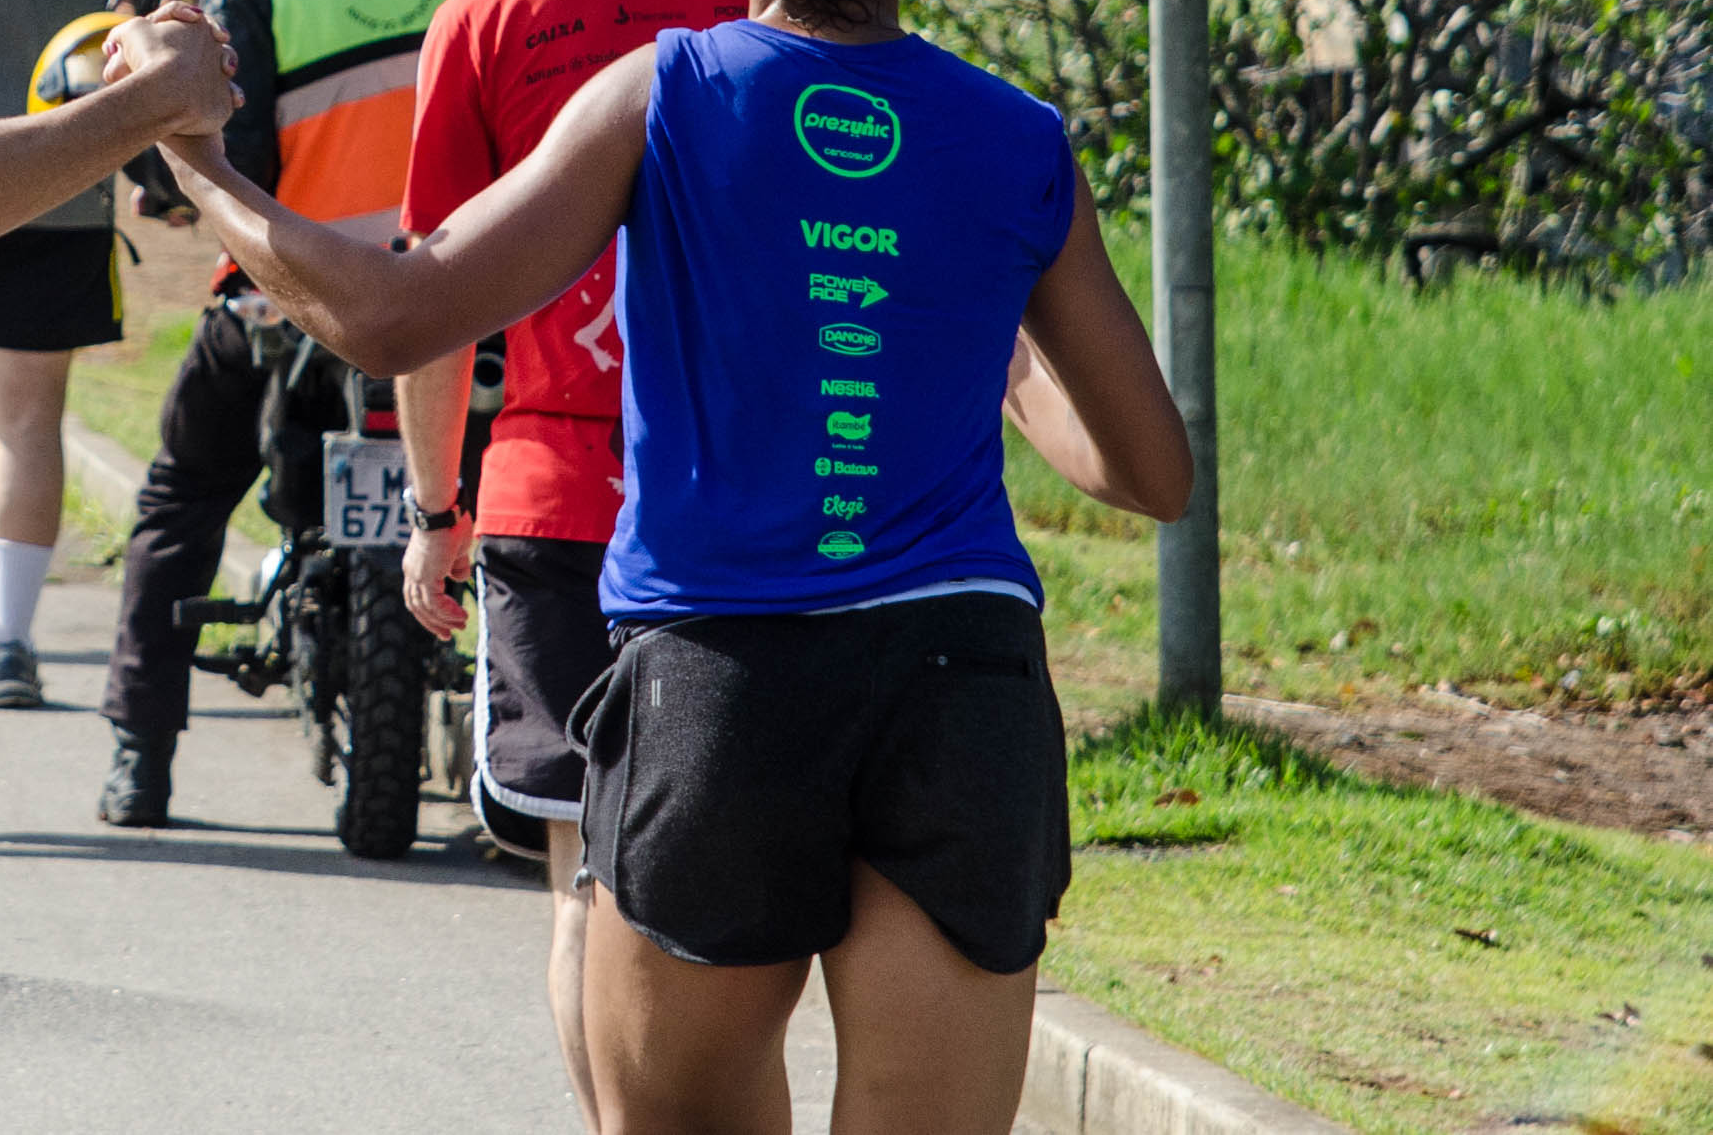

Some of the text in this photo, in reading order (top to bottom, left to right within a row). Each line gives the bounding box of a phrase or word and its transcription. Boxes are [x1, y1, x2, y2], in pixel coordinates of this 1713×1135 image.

[525, 18, 585, 49] CAIXA
[804, 113, 890, 138] prezunic
[800, 219, 900, 257] VIGOR
[834, 461, 878, 475] Batavo
